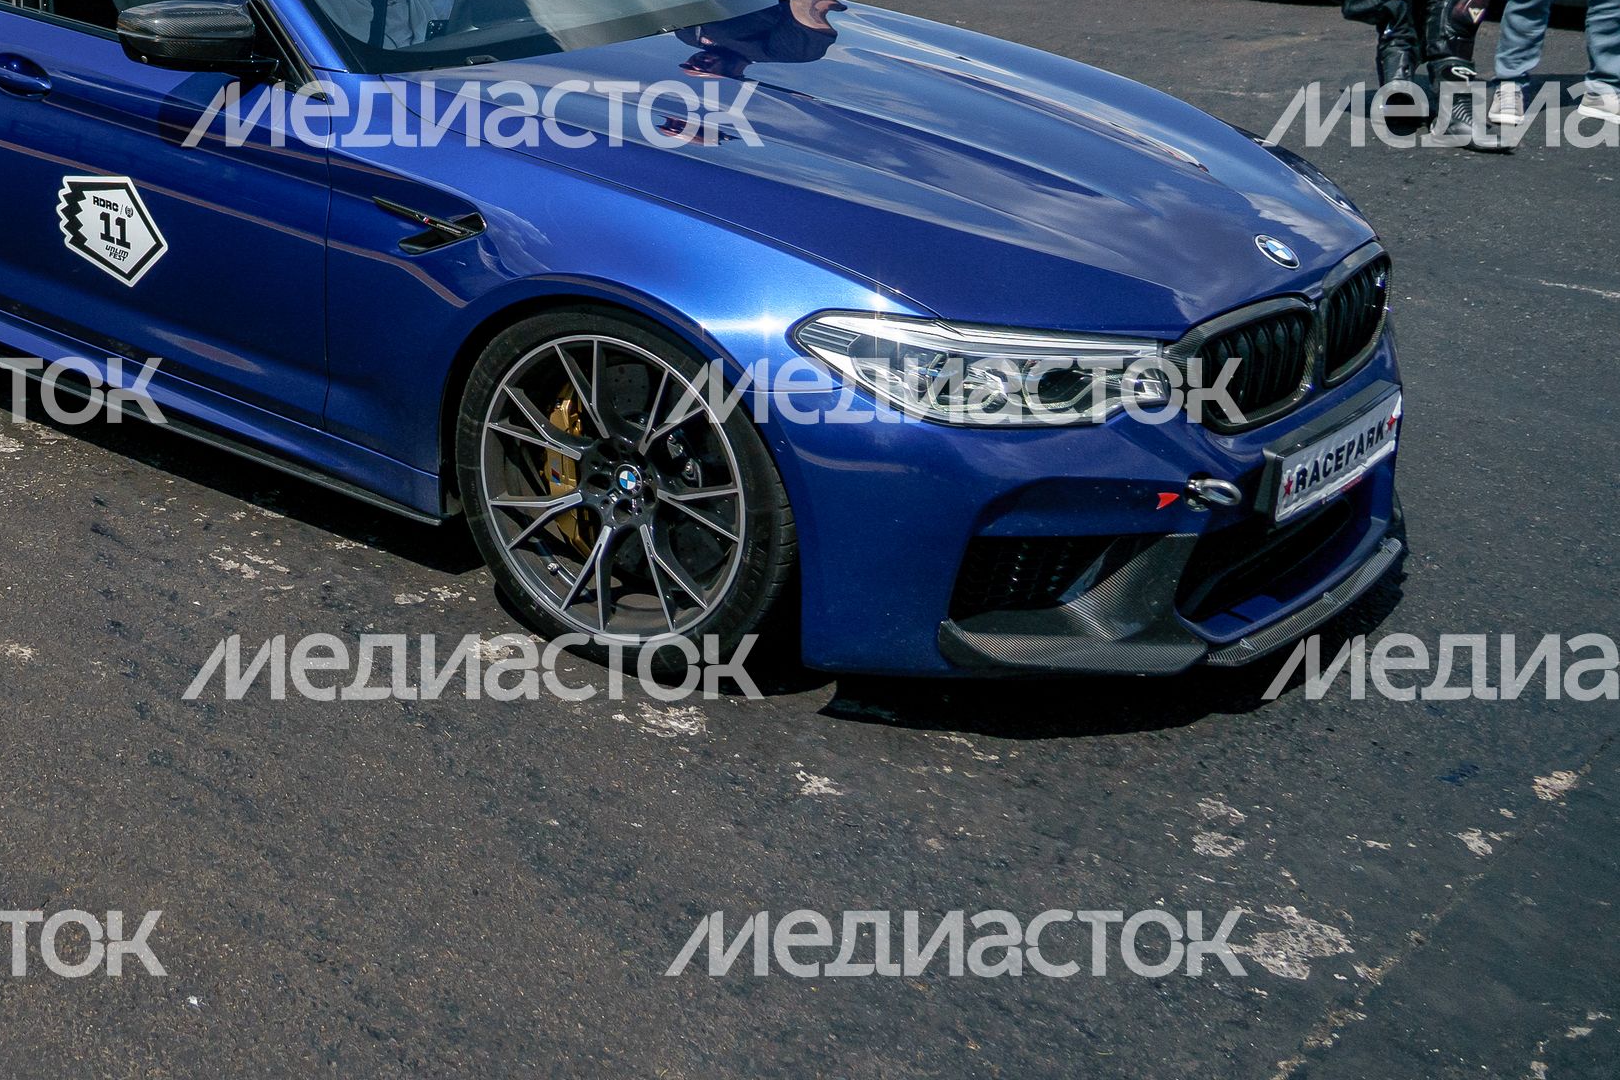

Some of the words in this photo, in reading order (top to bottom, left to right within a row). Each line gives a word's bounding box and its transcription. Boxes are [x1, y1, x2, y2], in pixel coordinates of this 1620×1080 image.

[92, 195, 119, 213] RDRC
[99, 211, 131, 250] 11
[1294, 419, 1385, 494] RACEPARK
